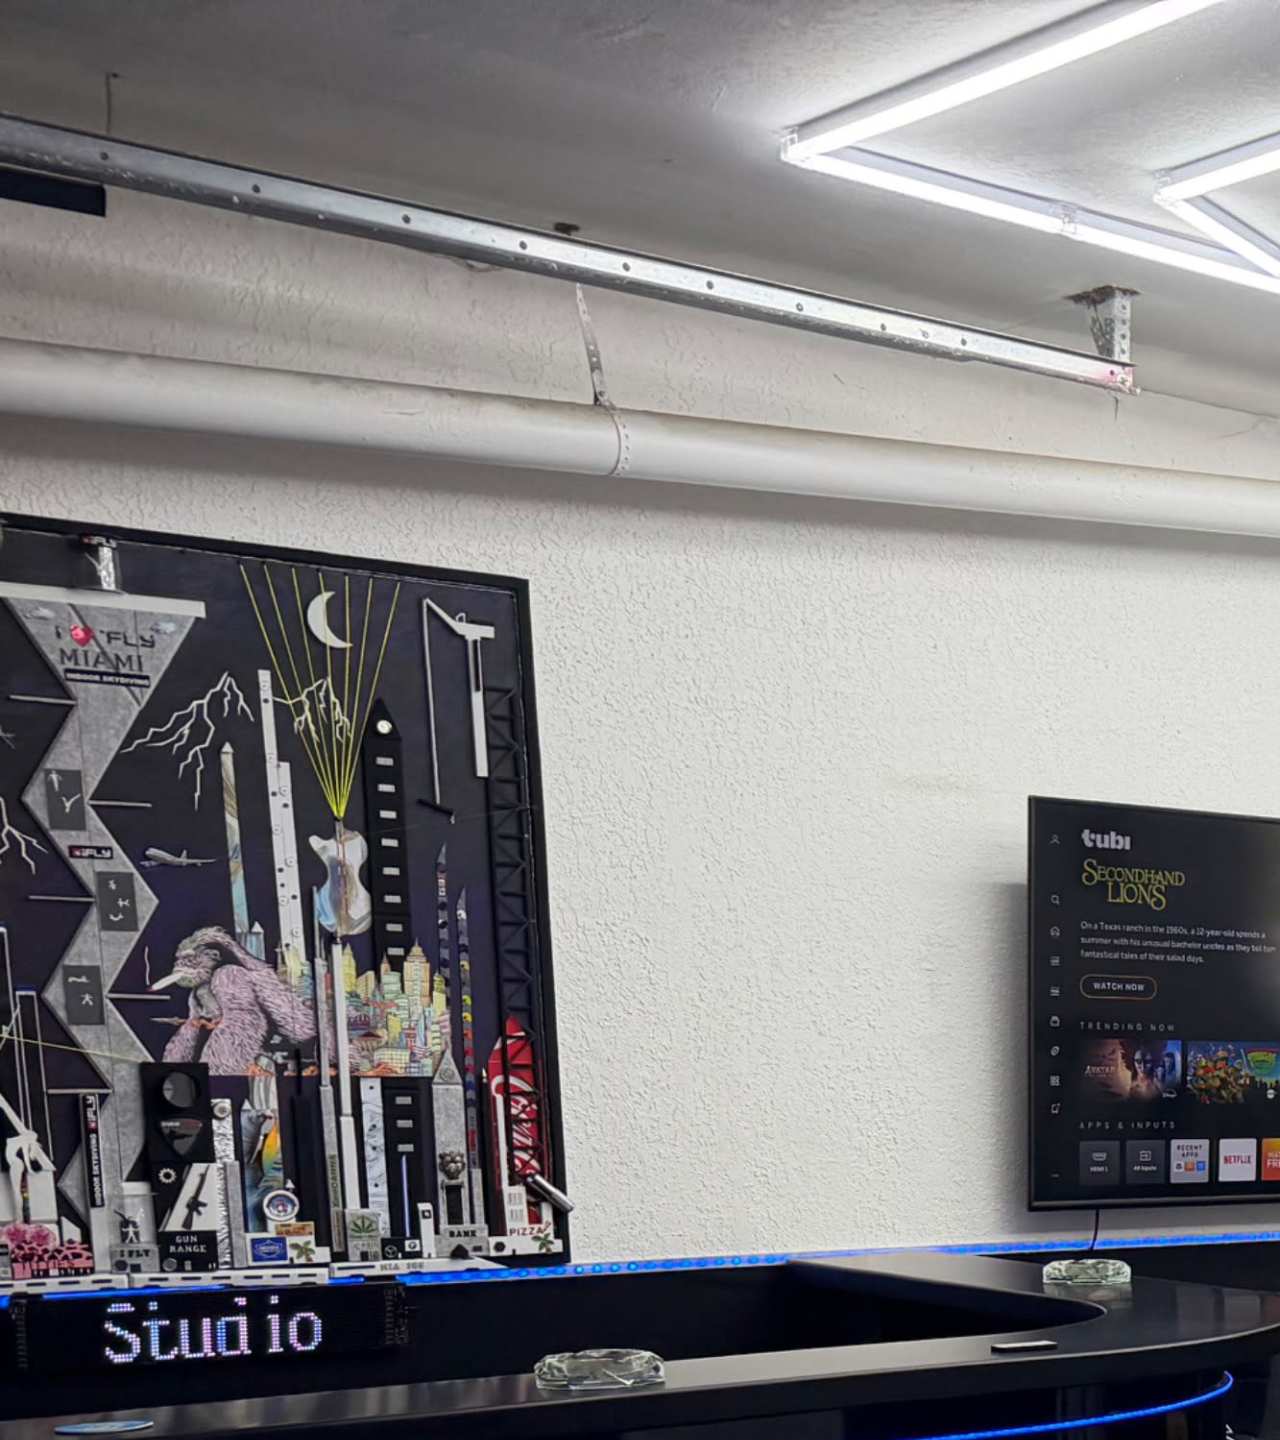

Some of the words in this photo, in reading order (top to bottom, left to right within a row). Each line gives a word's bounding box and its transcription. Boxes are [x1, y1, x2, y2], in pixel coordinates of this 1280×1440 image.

[60, 648, 143, 672] MIAMI
[1082, 829, 1131, 850] tubi
[1082, 858, 1185, 887] SECONDHAND
[1107, 881, 1167, 910] LIONS
[1100, 922, 1121, 931] Texas
[1123, 924, 1143, 933] ranch
[1236, 930, 1260, 938] spends
[1080, 937, 1111, 945] summer
[1113, 938, 1128, 946] with
[1142, 940, 1170, 948] unusual
[1171, 941, 1202, 949] bachelor
[1203, 943, 1225, 951] uncles
[1235, 944, 1250, 953] they
[1080, 949, 1119, 959] fantastical
[1120, 951, 1138, 960] tales
[1148, 952, 1165, 961] their
[1093, 982, 1124, 991] WATCH
[1125, 983, 1145, 991] NOW
[1080, 1021, 1143, 1031] TRENDING
[1150, 1023, 1175, 1032] NOW
[1079, 1121, 1110, 1130] APPS
[1131, 1121, 1176, 1130] INPUTS
[1223, 1155, 1252, 1165] NETFLIX
[448, 1229, 478, 1238] BANK
[508, 1225, 545, 1237] PIZZA
[175, 1234, 198, 1244] GUN
[168, 1244, 208, 1254] RANGE
[104, 1295, 322, 1363] Studio
